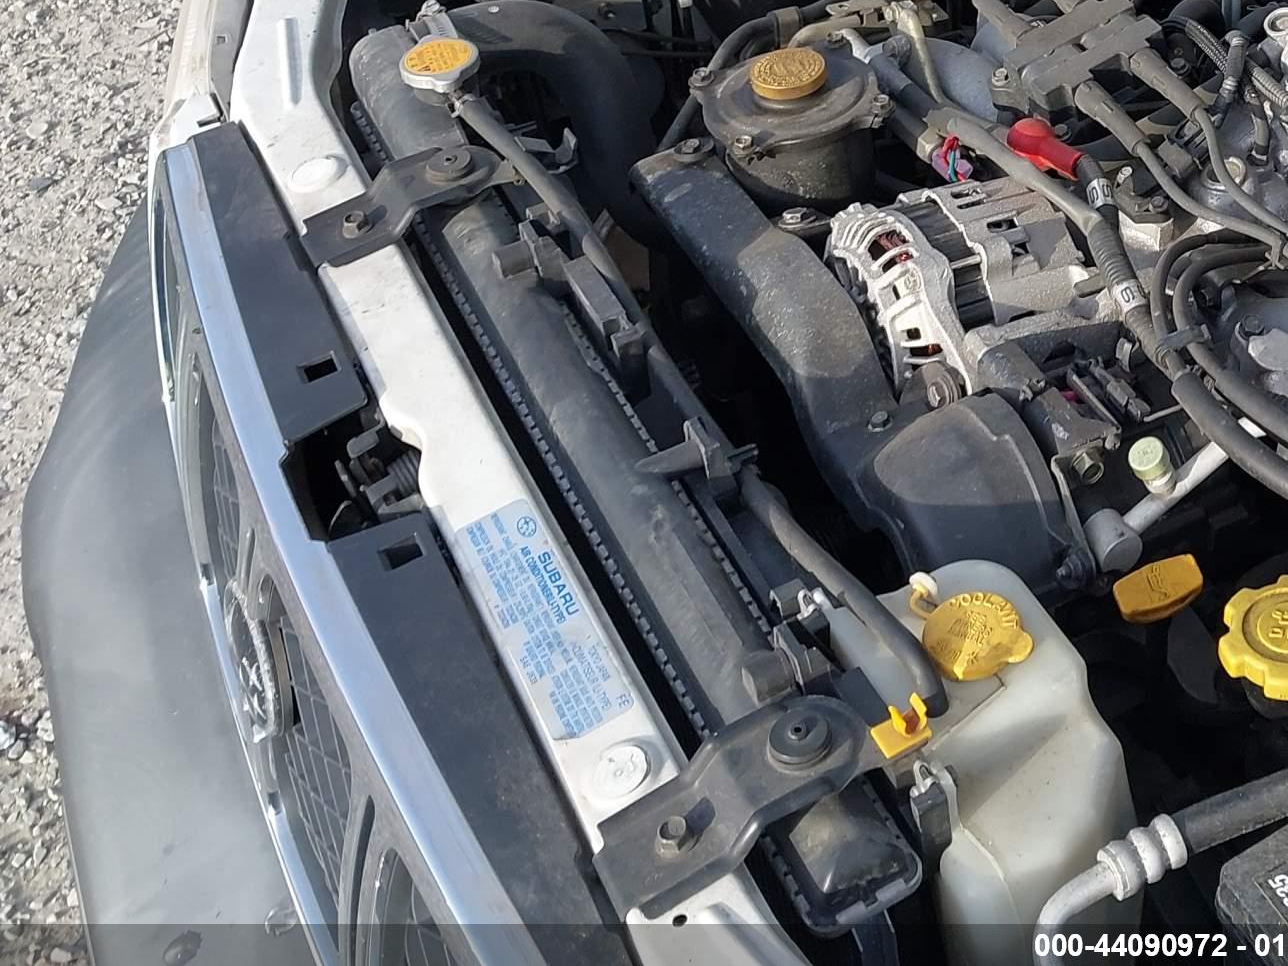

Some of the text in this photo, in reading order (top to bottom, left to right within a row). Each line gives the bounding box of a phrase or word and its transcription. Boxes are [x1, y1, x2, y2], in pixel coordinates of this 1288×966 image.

[518, 544, 531, 559] AIR
[536, 549, 579, 617] SUBARU
[948, 591, 1017, 629] COOLANT
